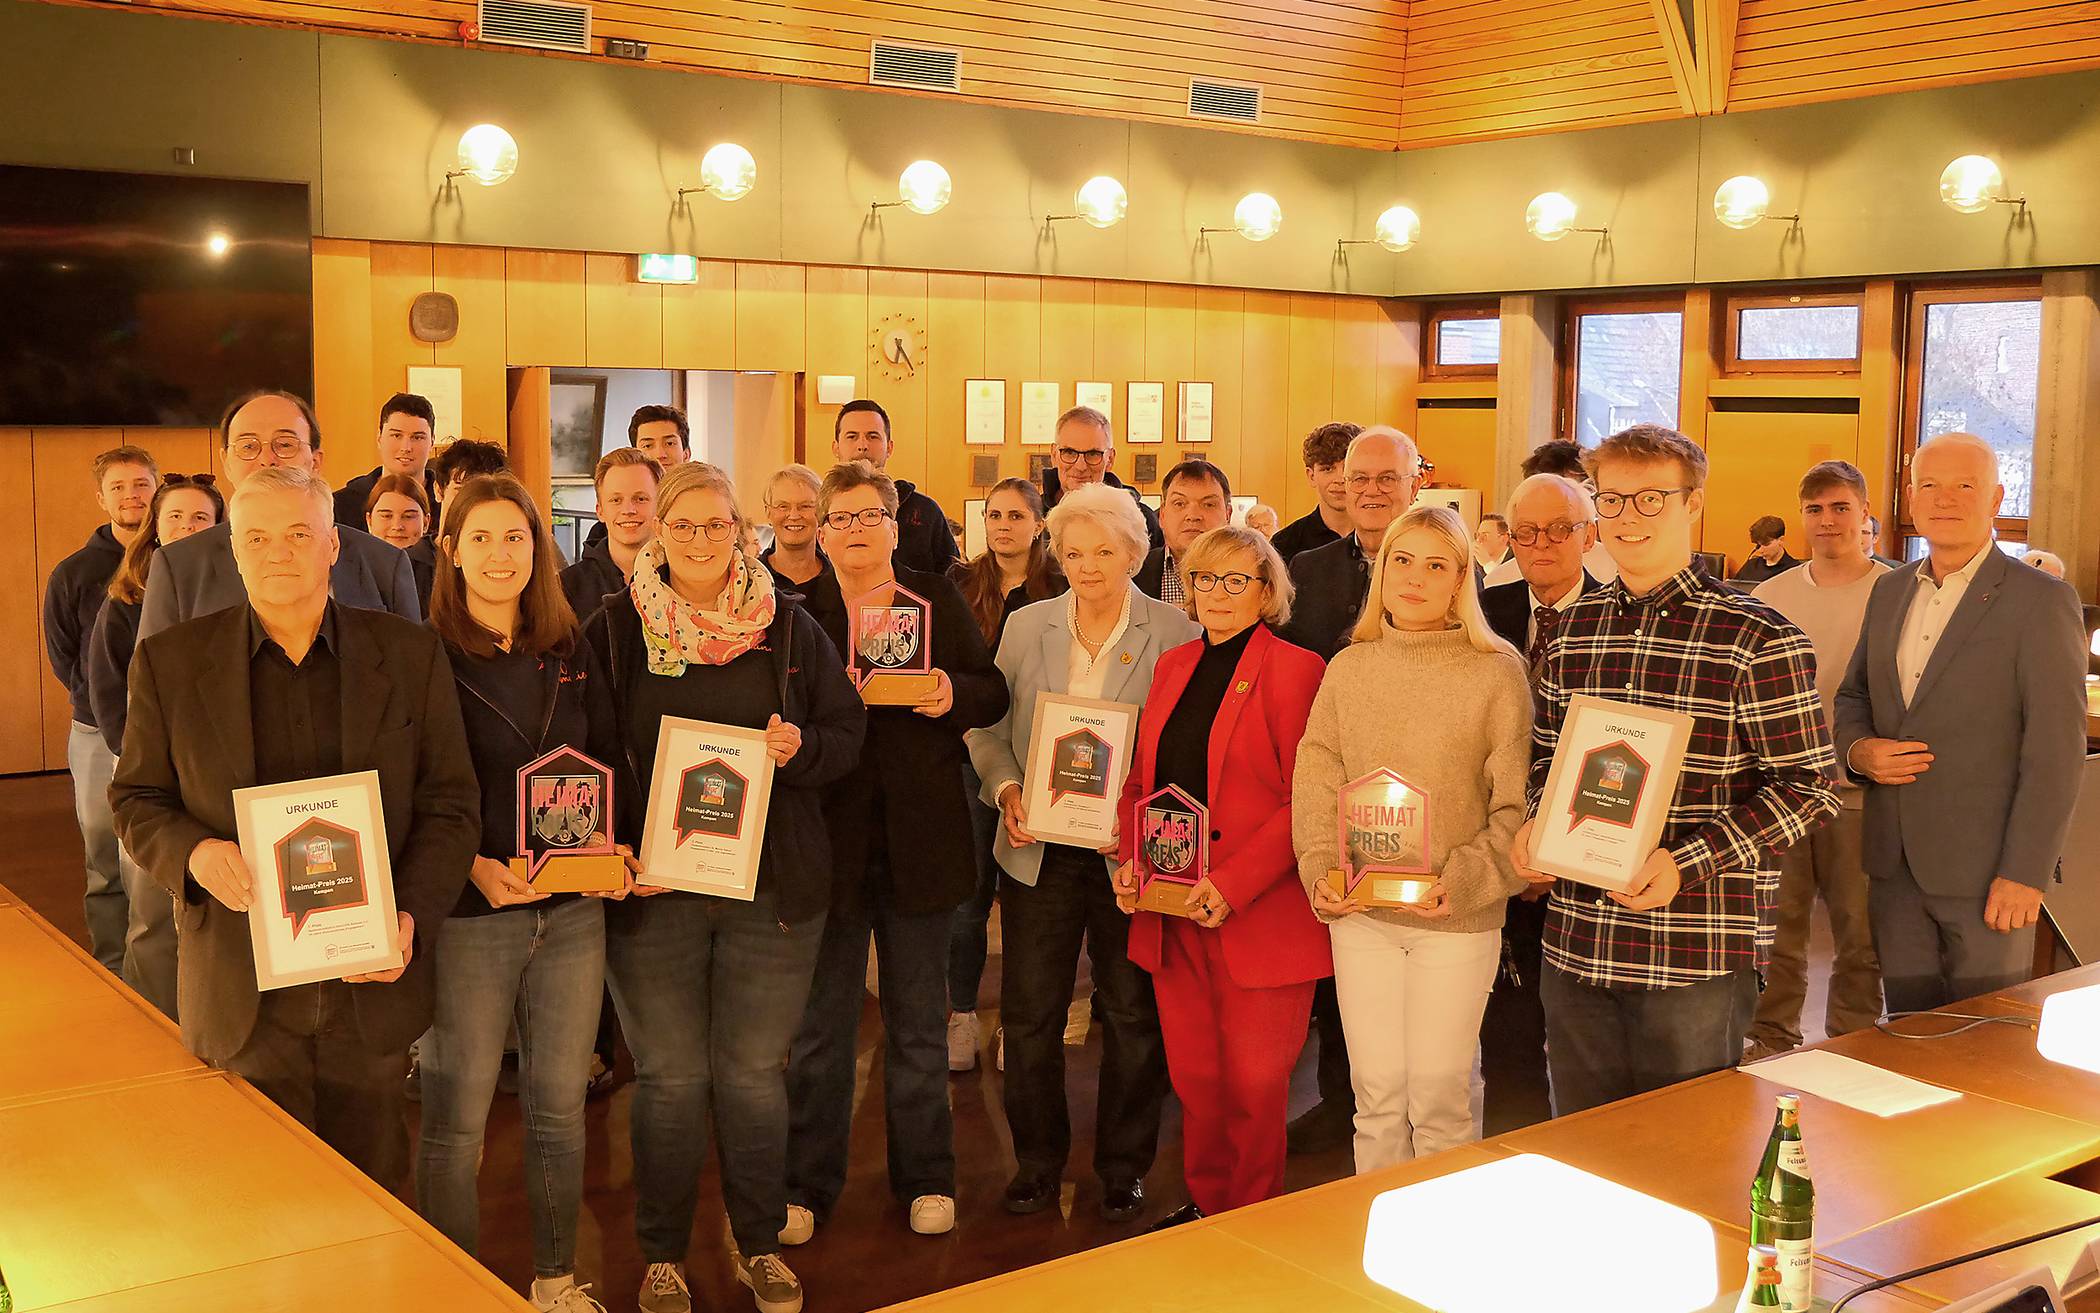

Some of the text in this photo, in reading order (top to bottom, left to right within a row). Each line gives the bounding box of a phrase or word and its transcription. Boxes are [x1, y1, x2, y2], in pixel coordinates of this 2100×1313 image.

[1069, 715, 1106, 727] URKUNDE
[1604, 724, 1647, 739] URKUNDE
[698, 743, 741, 757] URKUNDE
[286, 799, 339, 815] URKUNDE
[720, 809, 734, 819] 2025
[1351, 804, 1417, 827] HEIMAT
[1350, 831, 1401, 853] PREIS
[291, 876, 354, 892] Heimat-Preis 2025
